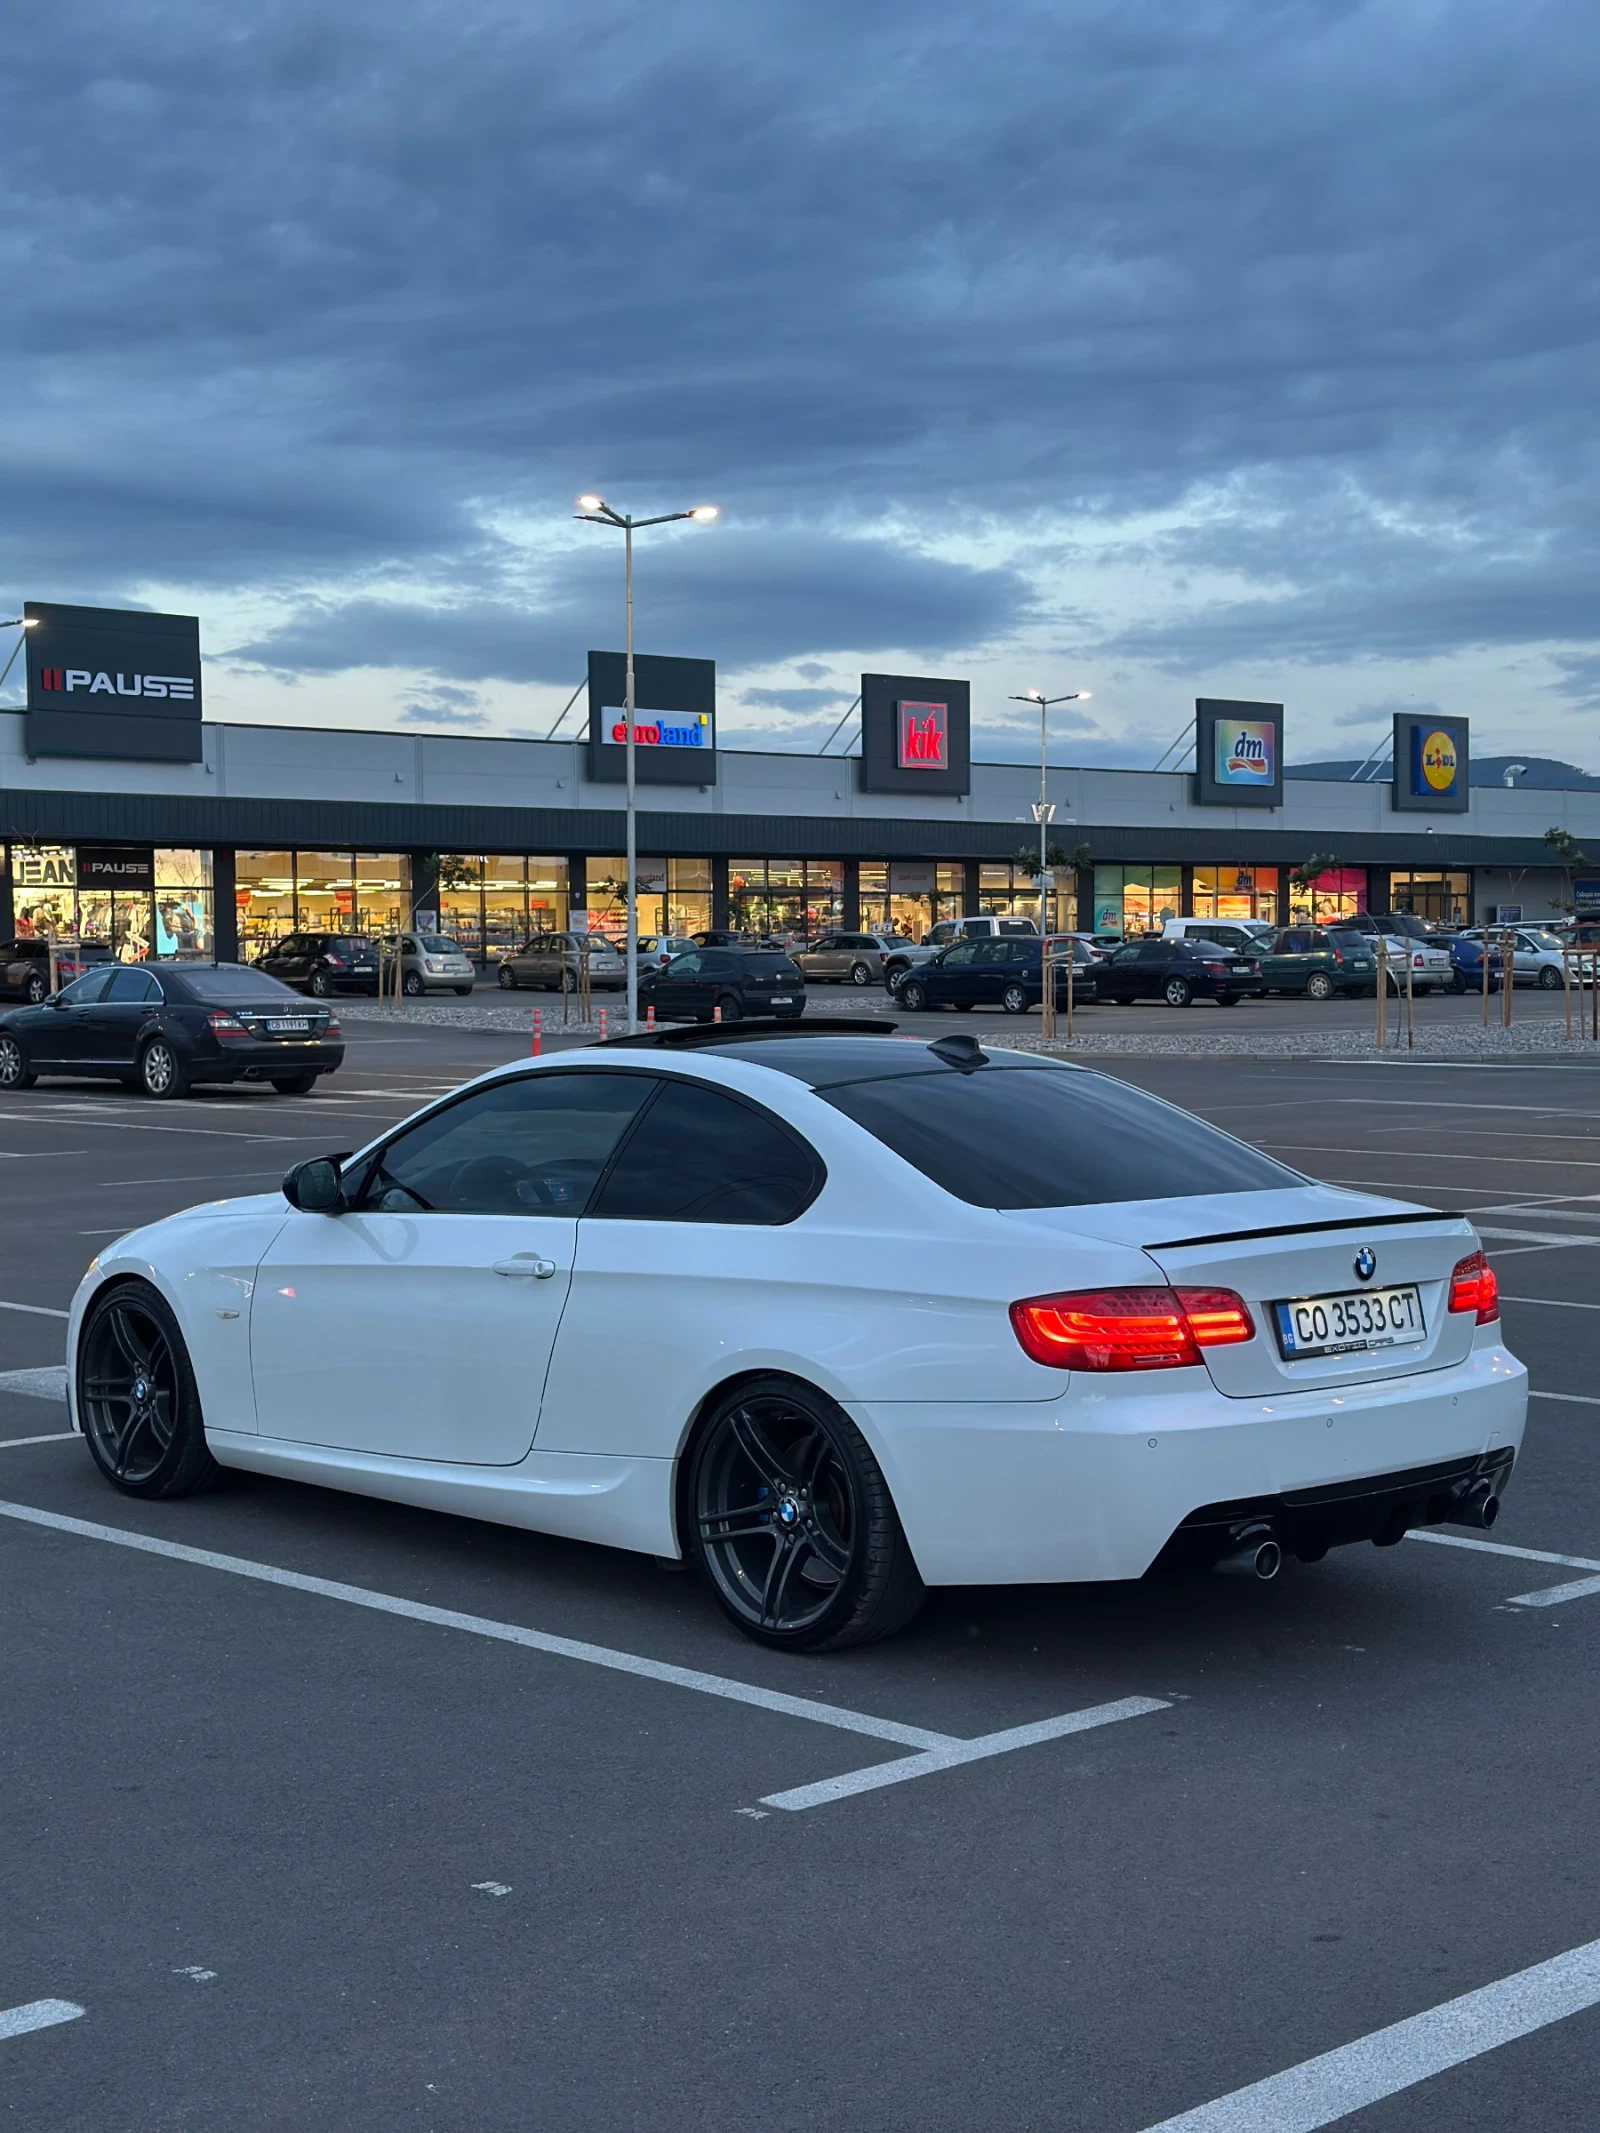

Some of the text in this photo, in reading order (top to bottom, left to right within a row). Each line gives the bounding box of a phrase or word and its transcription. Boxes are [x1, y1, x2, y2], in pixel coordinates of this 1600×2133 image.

[65, 669, 194, 700] PAUSE
[906, 711, 943, 760] kik
[1234, 731, 1263, 759] dm
[92, 863, 149, 873] PAUSE
[1237, 872, 1252, 885] dm
[1102, 909, 1117, 921] dm
[1295, 1293, 1414, 1343] CO 3533 CT
[1282, 1333, 1294, 1345] BG
[1324, 1341, 1366, 1354] EXOTIC
